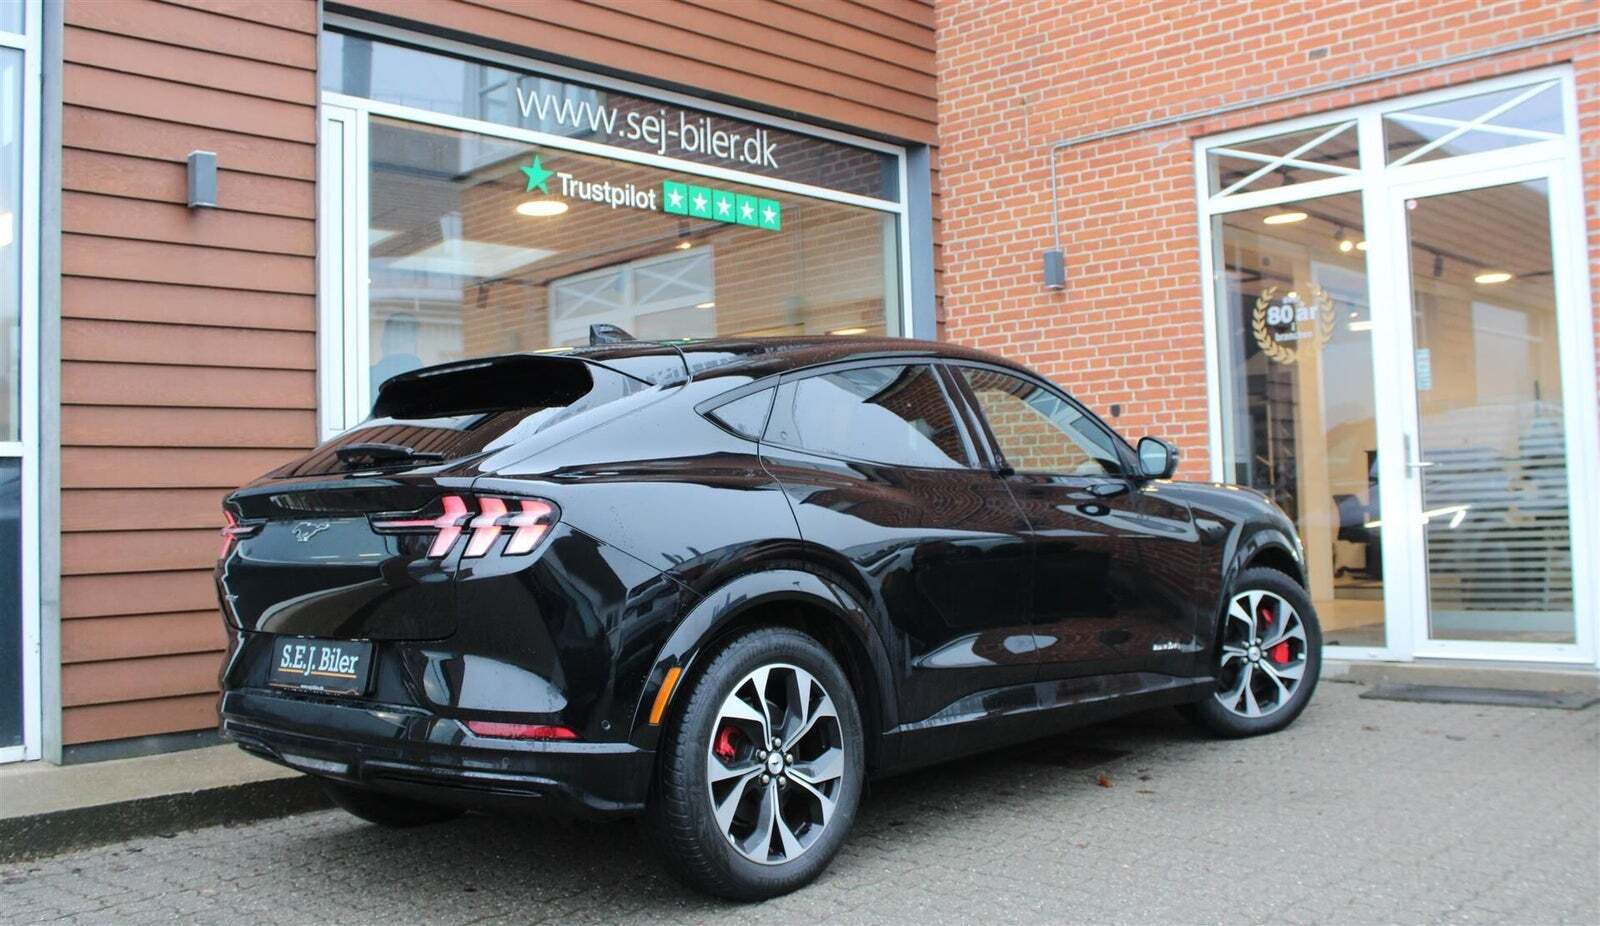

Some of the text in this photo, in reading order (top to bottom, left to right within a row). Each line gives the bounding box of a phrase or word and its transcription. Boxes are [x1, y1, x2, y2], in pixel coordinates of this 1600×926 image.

[517, 87, 778, 169] www.sej-biler.dk
[557, 172, 656, 210] Trustpilot
[1266, 304, 1294, 325] 80
[280, 644, 359, 676] S.E.J. Biler
